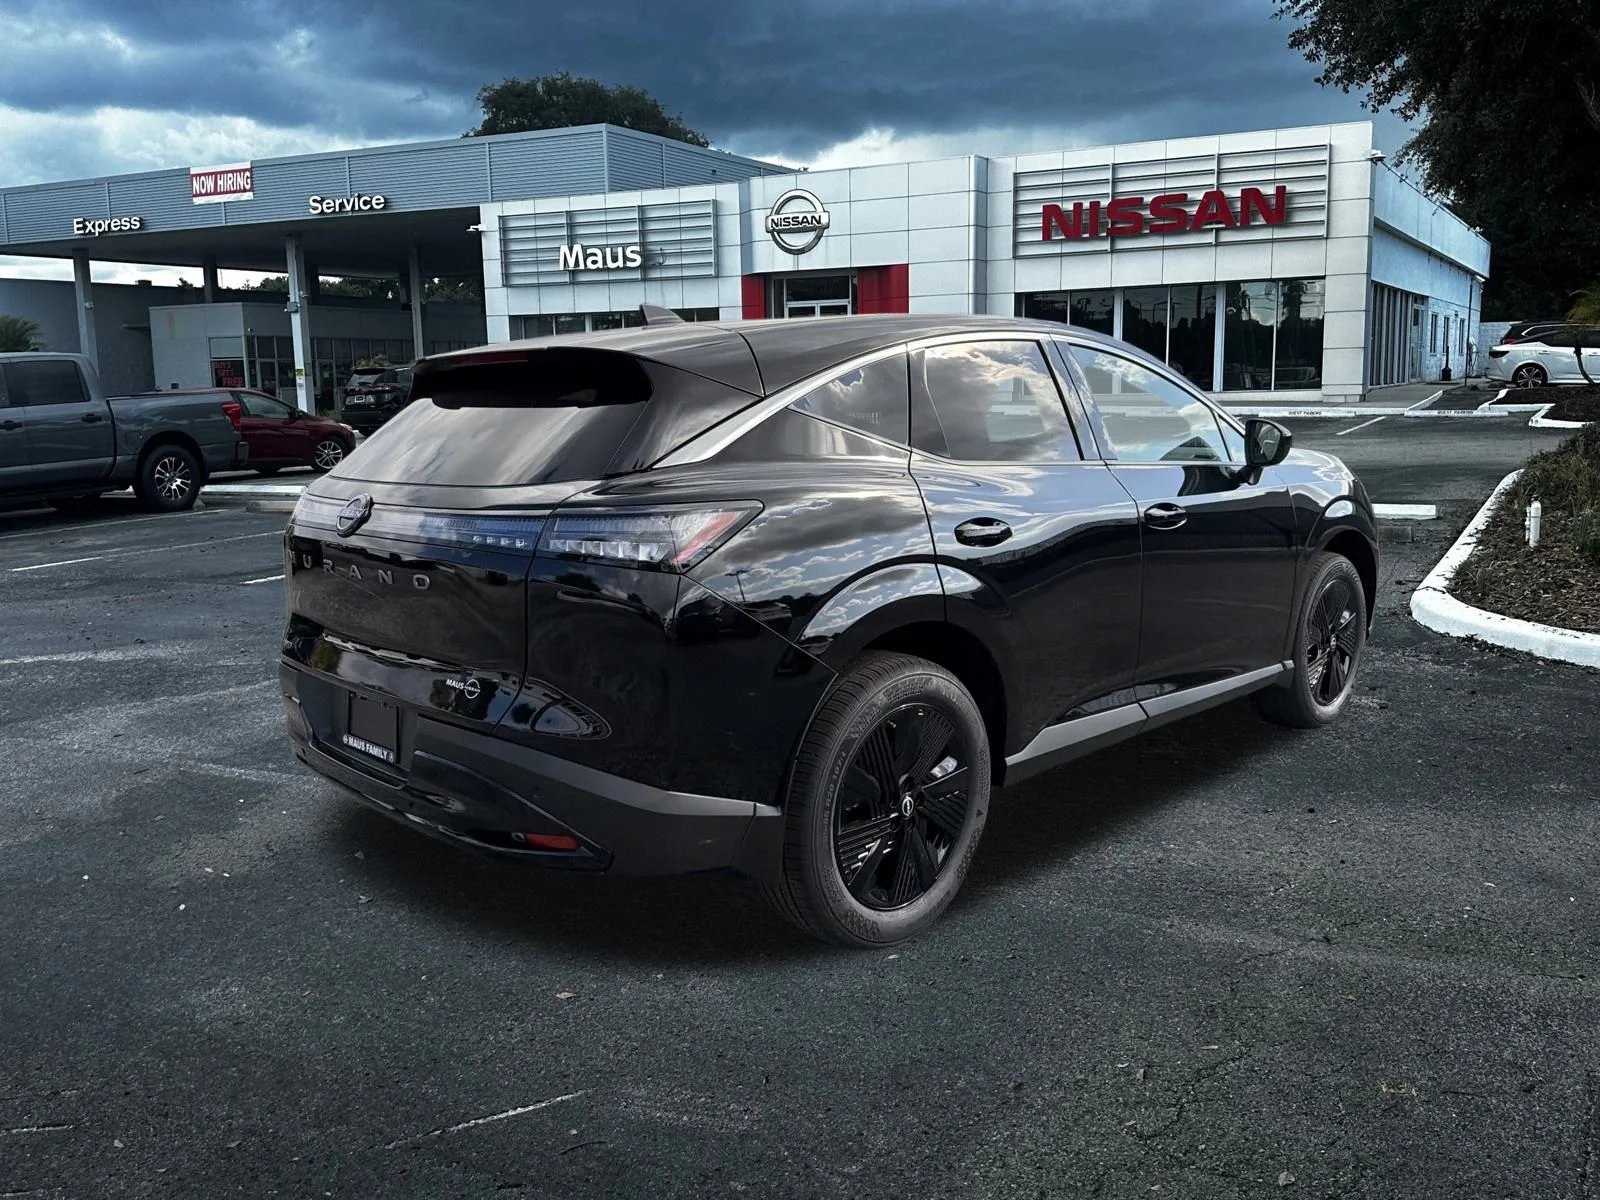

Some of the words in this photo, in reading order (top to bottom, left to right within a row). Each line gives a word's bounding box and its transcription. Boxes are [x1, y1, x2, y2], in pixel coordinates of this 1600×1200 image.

[192, 174, 215, 195] NOW
[217, 171, 251, 193] HIRING
[308, 192, 386, 215] Service
[1041, 184, 1287, 241] NISSAN
[72, 216, 141, 237] Express
[770, 214, 822, 230] NISSAN
[558, 243, 642, 271] Maus
[445, 679, 465, 690] MAUS
[348, 736, 365, 751] MAUS
[366, 743, 388, 760] FAMILY
